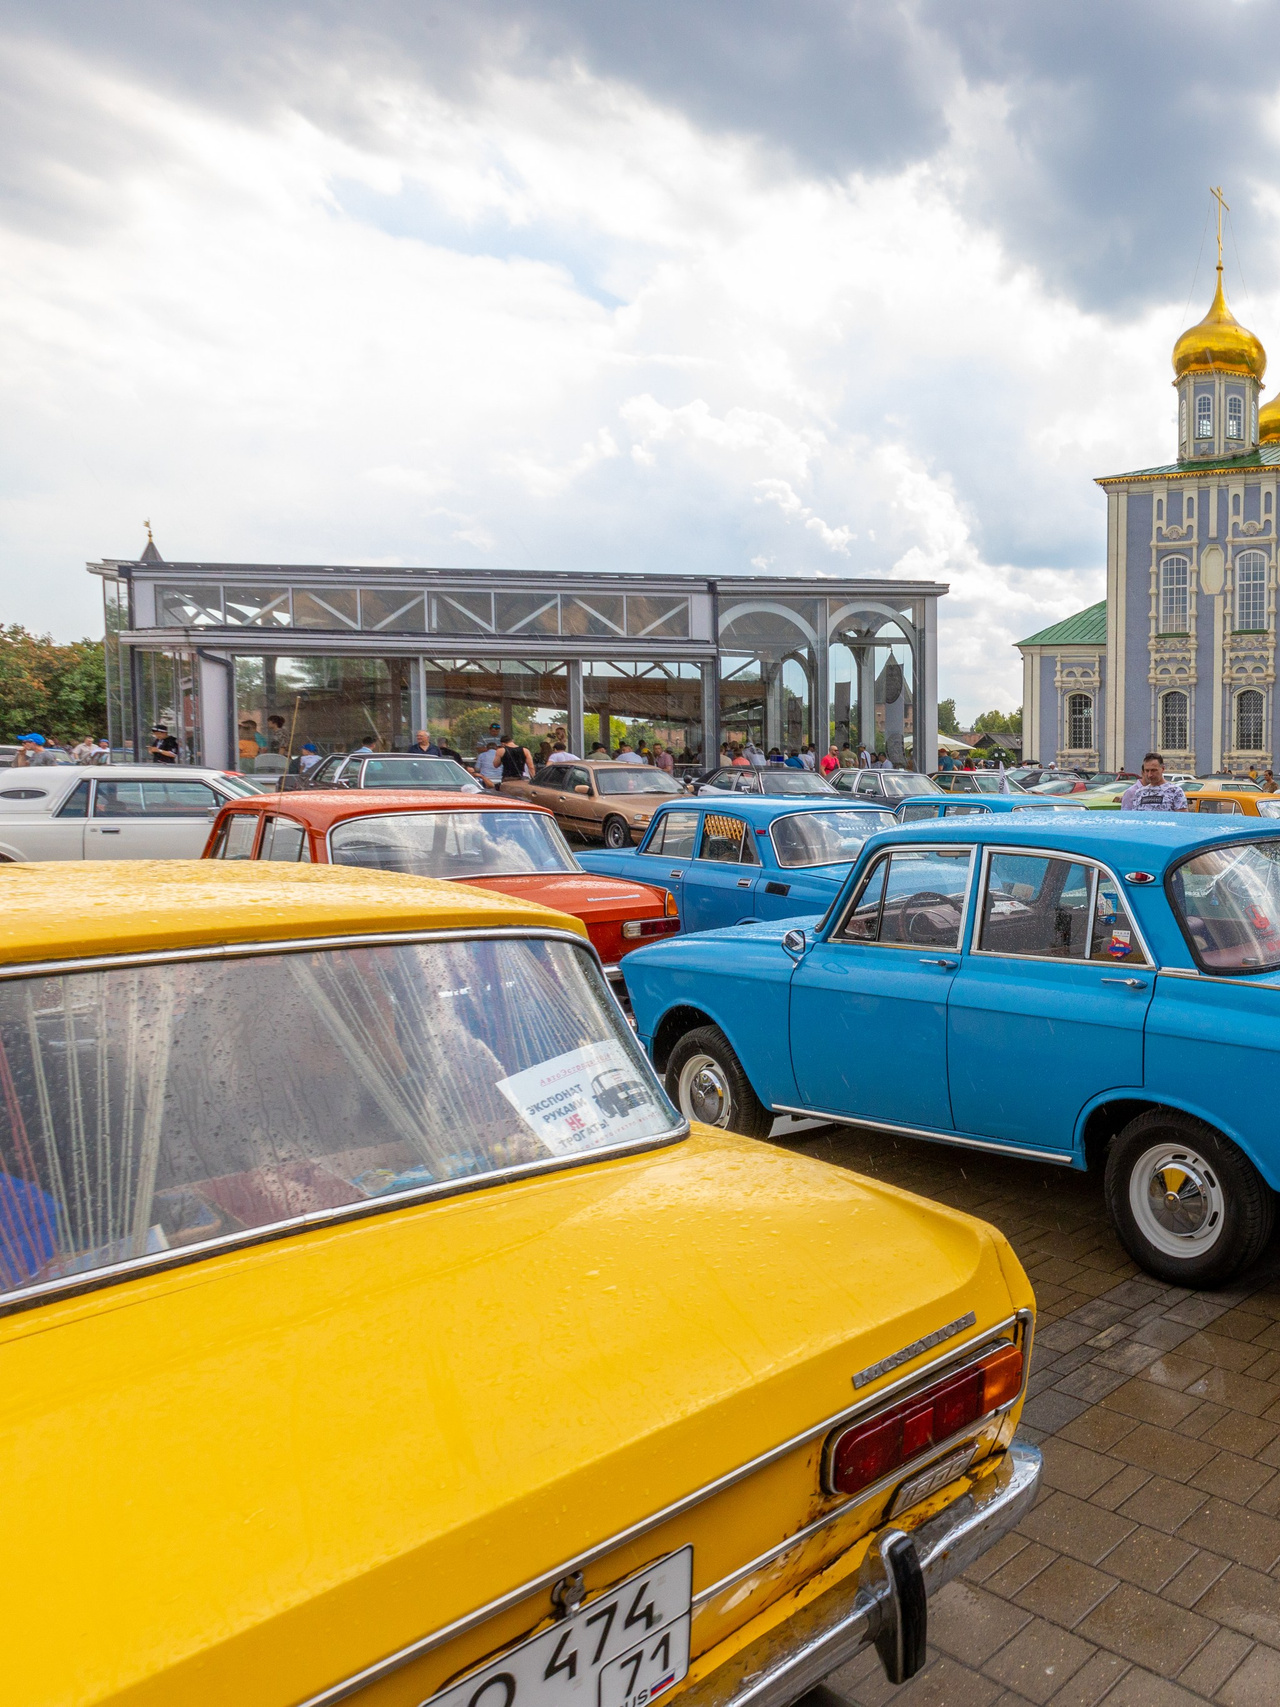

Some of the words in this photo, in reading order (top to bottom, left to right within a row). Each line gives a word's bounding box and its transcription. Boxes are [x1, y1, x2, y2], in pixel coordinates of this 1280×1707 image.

[525, 1083, 584, 1116] ЭКСПОНАТ
[542, 1097, 588, 1123] РУКАМИ
[558, 1118, 611, 1148] ТРОГАТЬ!
[564, 1112, 587, 1132] НЕ
[543, 1579, 656, 1682] 474
[618, 1631, 671, 1699] 71
